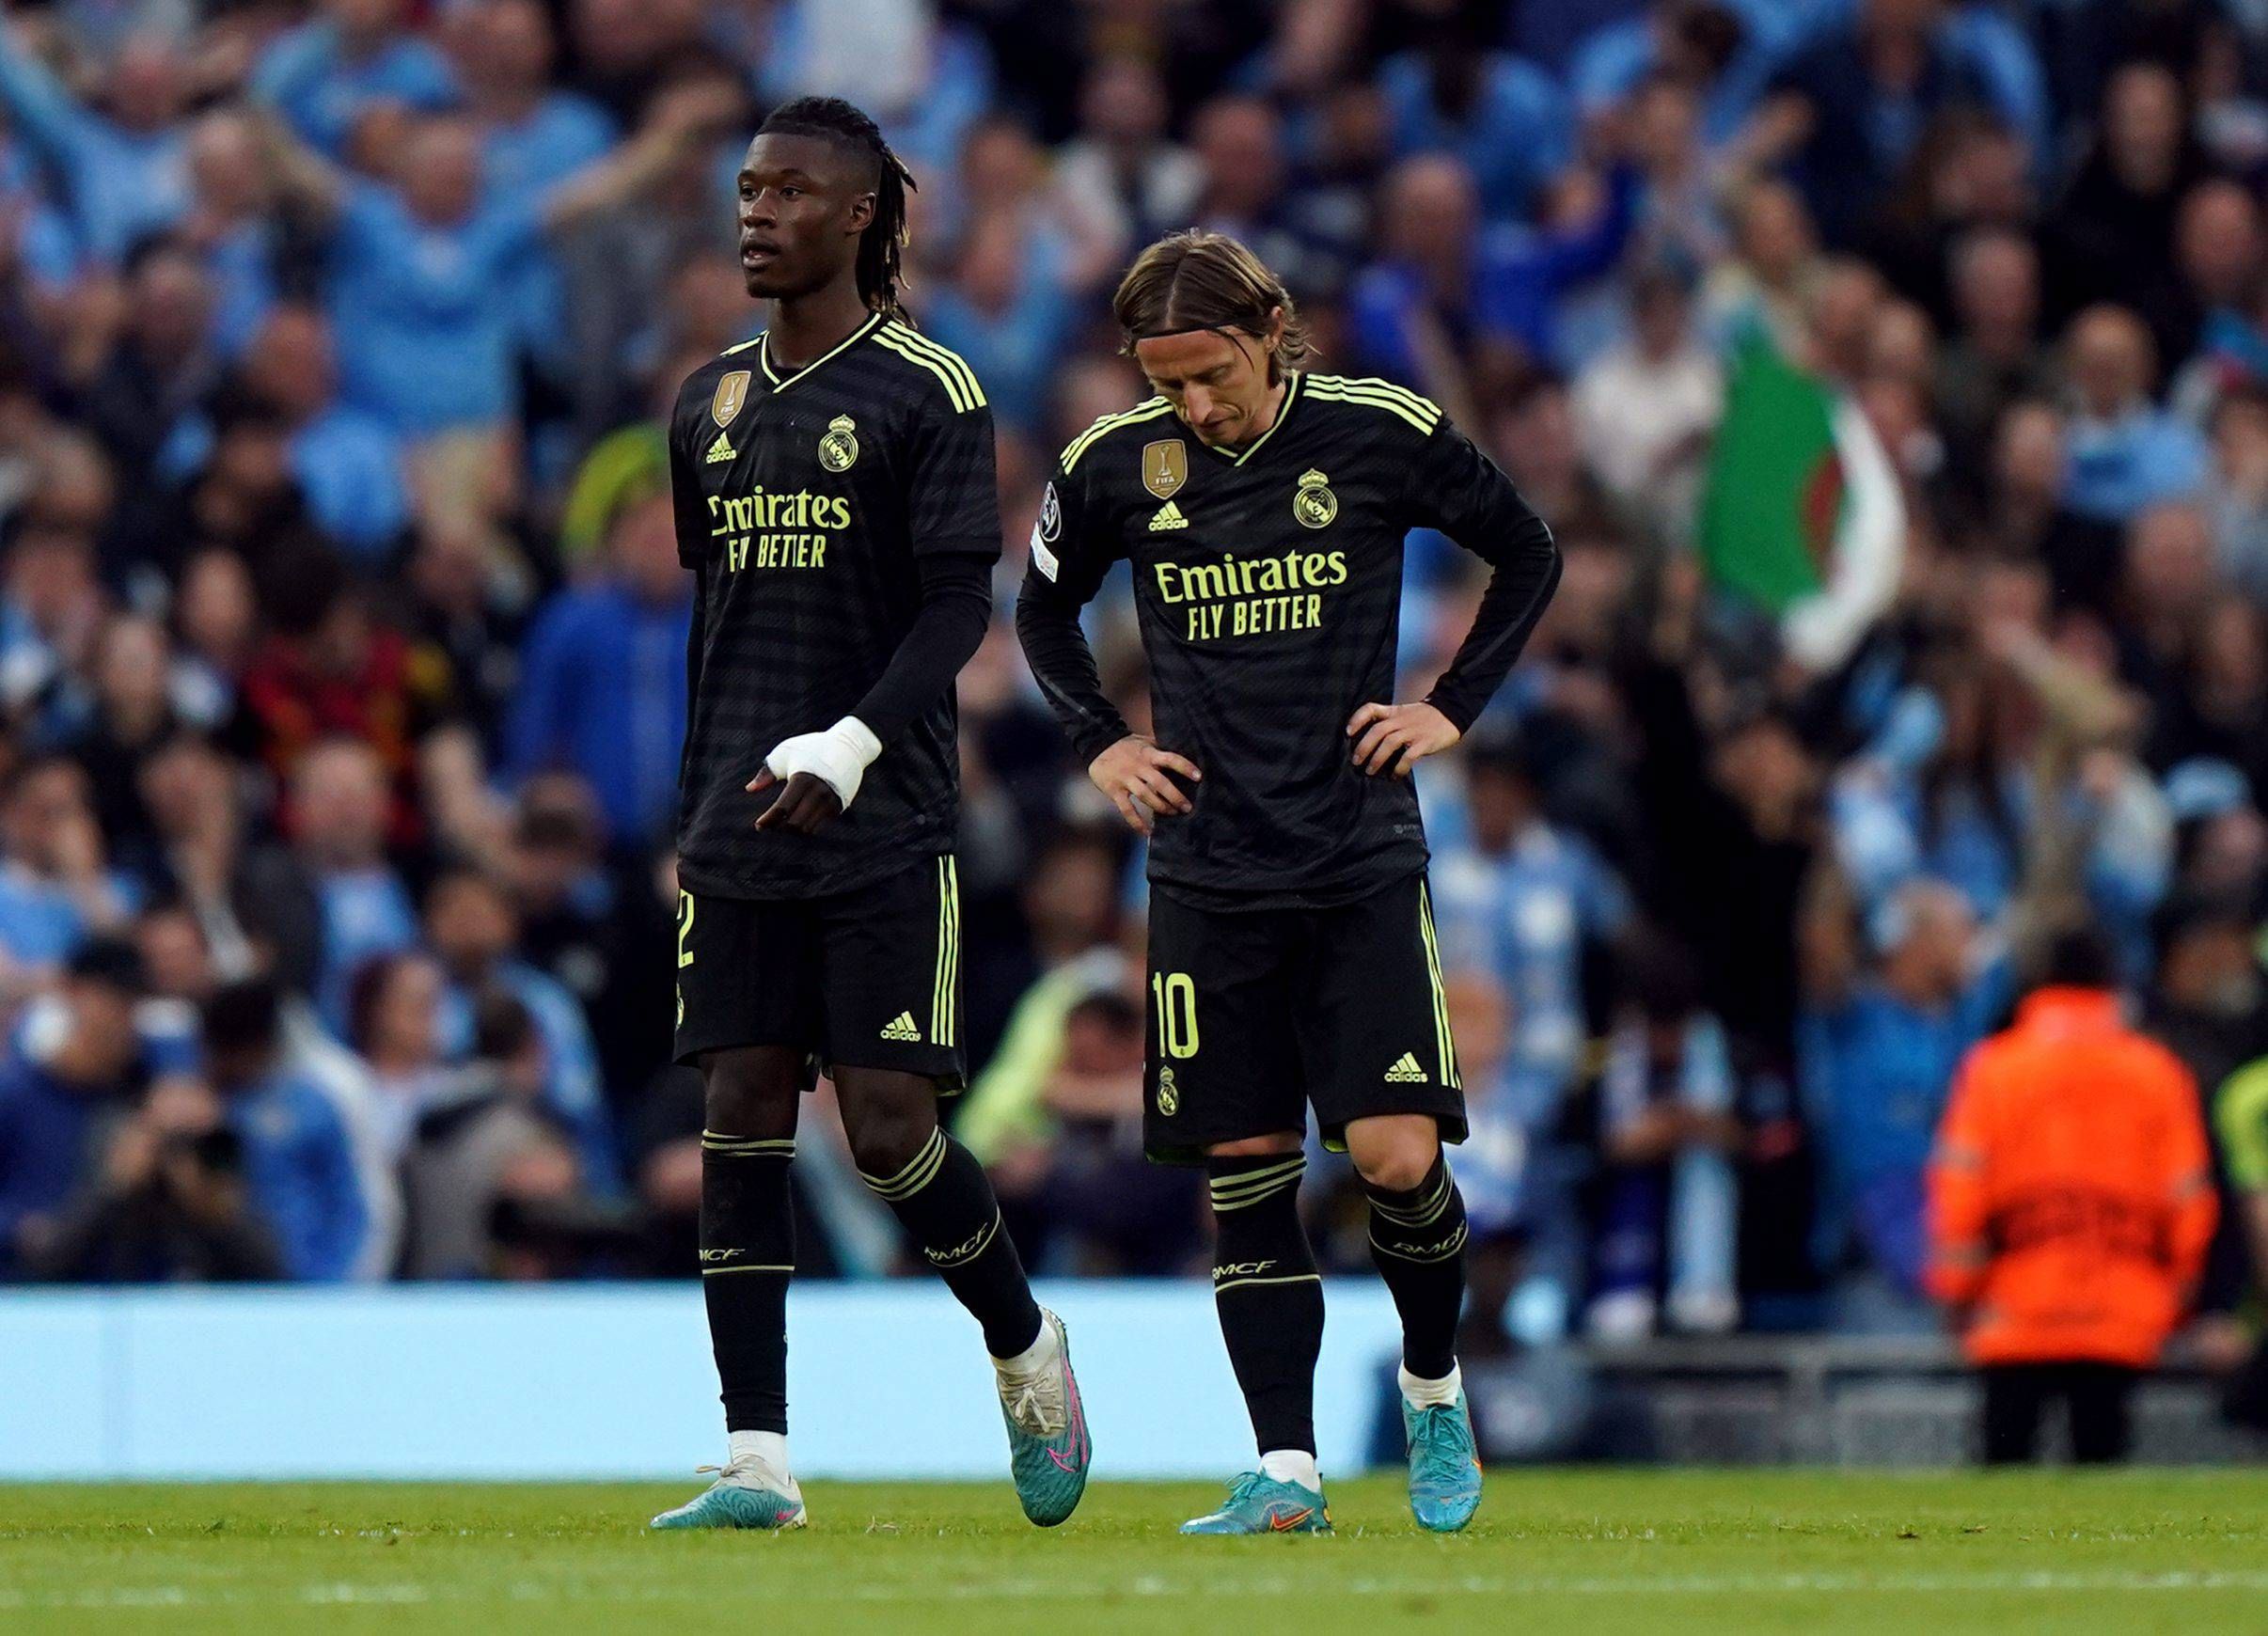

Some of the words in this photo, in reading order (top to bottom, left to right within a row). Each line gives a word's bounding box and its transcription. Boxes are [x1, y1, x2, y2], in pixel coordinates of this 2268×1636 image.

[706, 449, 737, 464] adidas
[1148, 518, 1189, 532] adidas
[1154, 549, 1348, 603] Emirates
[1187, 604, 1224, 641] FLY
[1233, 593, 1322, 637] BETTER
[1152, 971, 1200, 1060] 10
[880, 1029, 921, 1042] adidas
[1384, 1072, 1428, 1083] adidas
